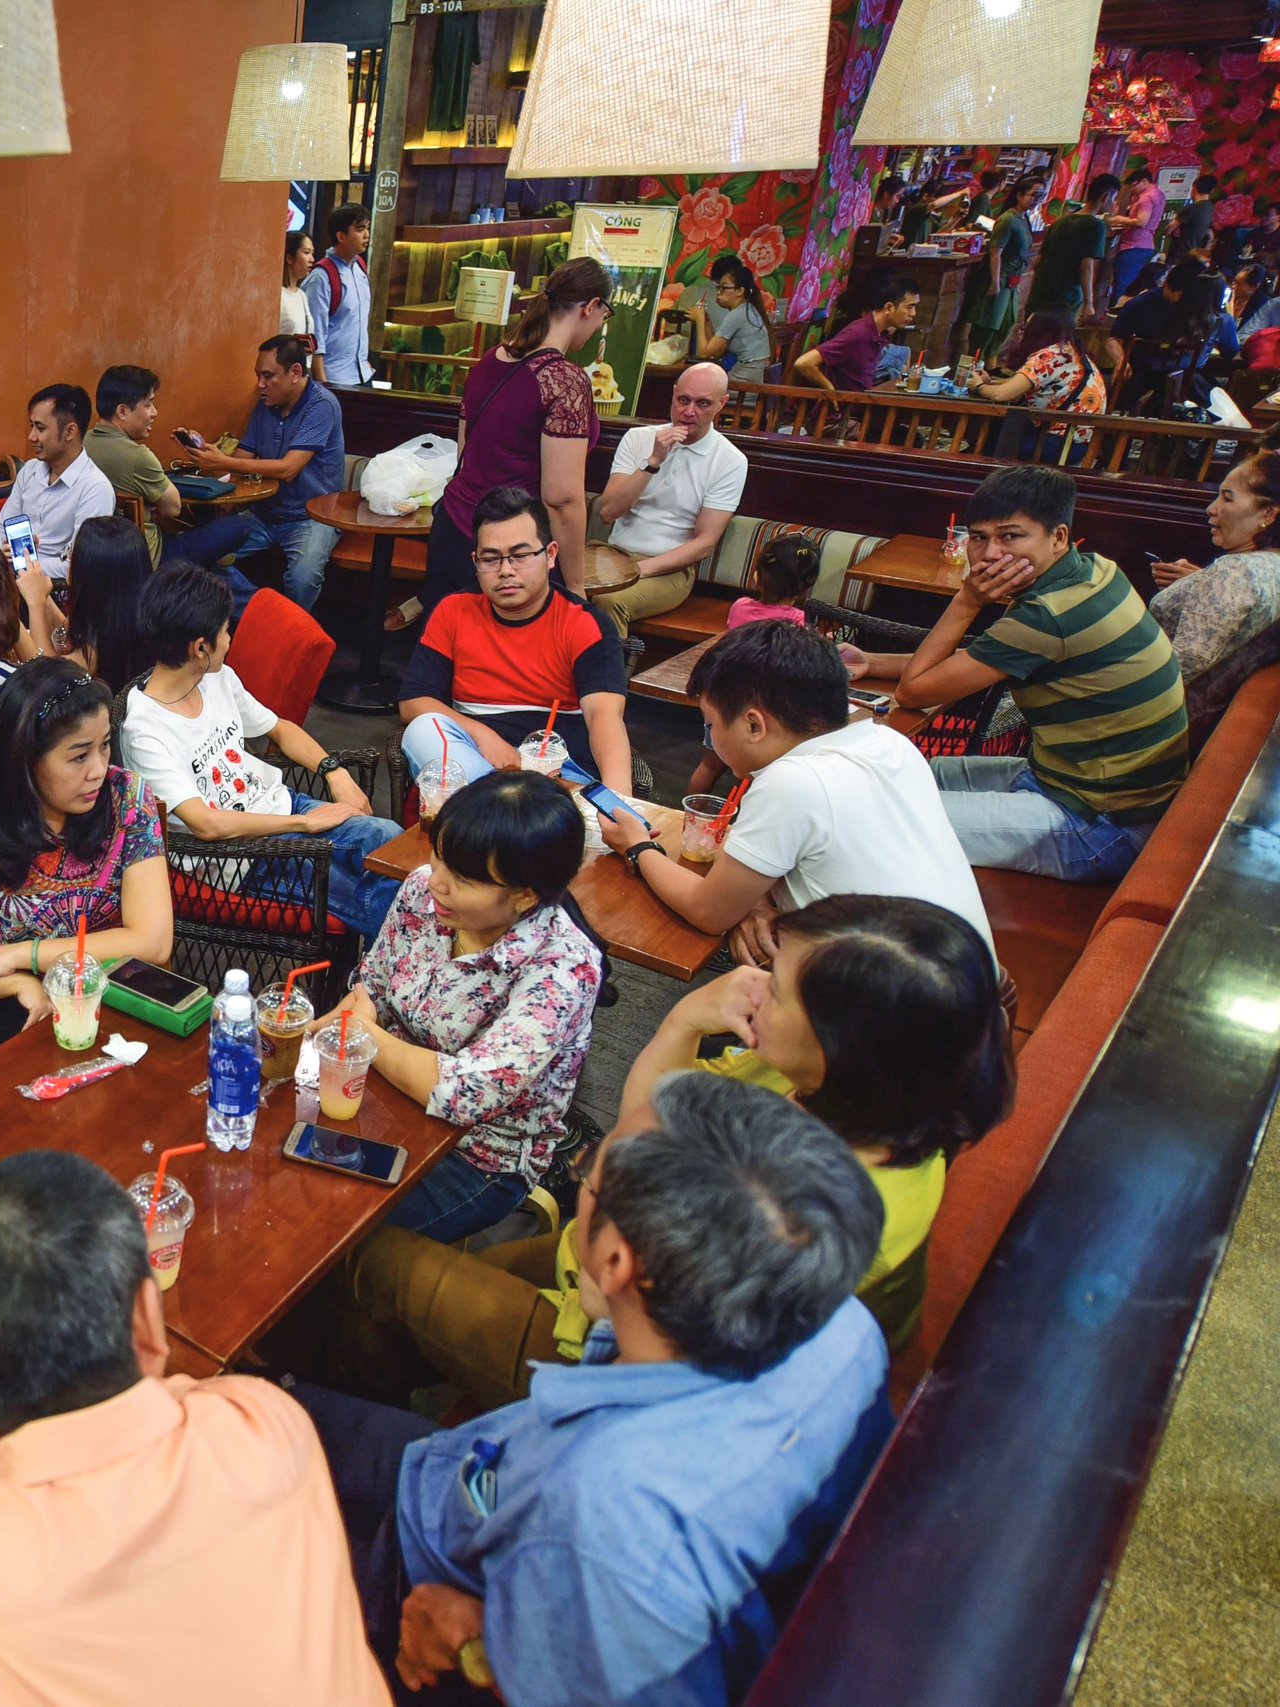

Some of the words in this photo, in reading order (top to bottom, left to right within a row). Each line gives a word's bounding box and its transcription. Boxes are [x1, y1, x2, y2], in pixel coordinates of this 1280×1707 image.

[420, 3, 434, 14] B3
[443, 1, 463, 12] 10A
[380, 176, 397, 188] LB3
[378, 195, 393, 206] 10A
[605, 214, 643, 228] CỘNG
[191, 720, 239, 775] Expressions
